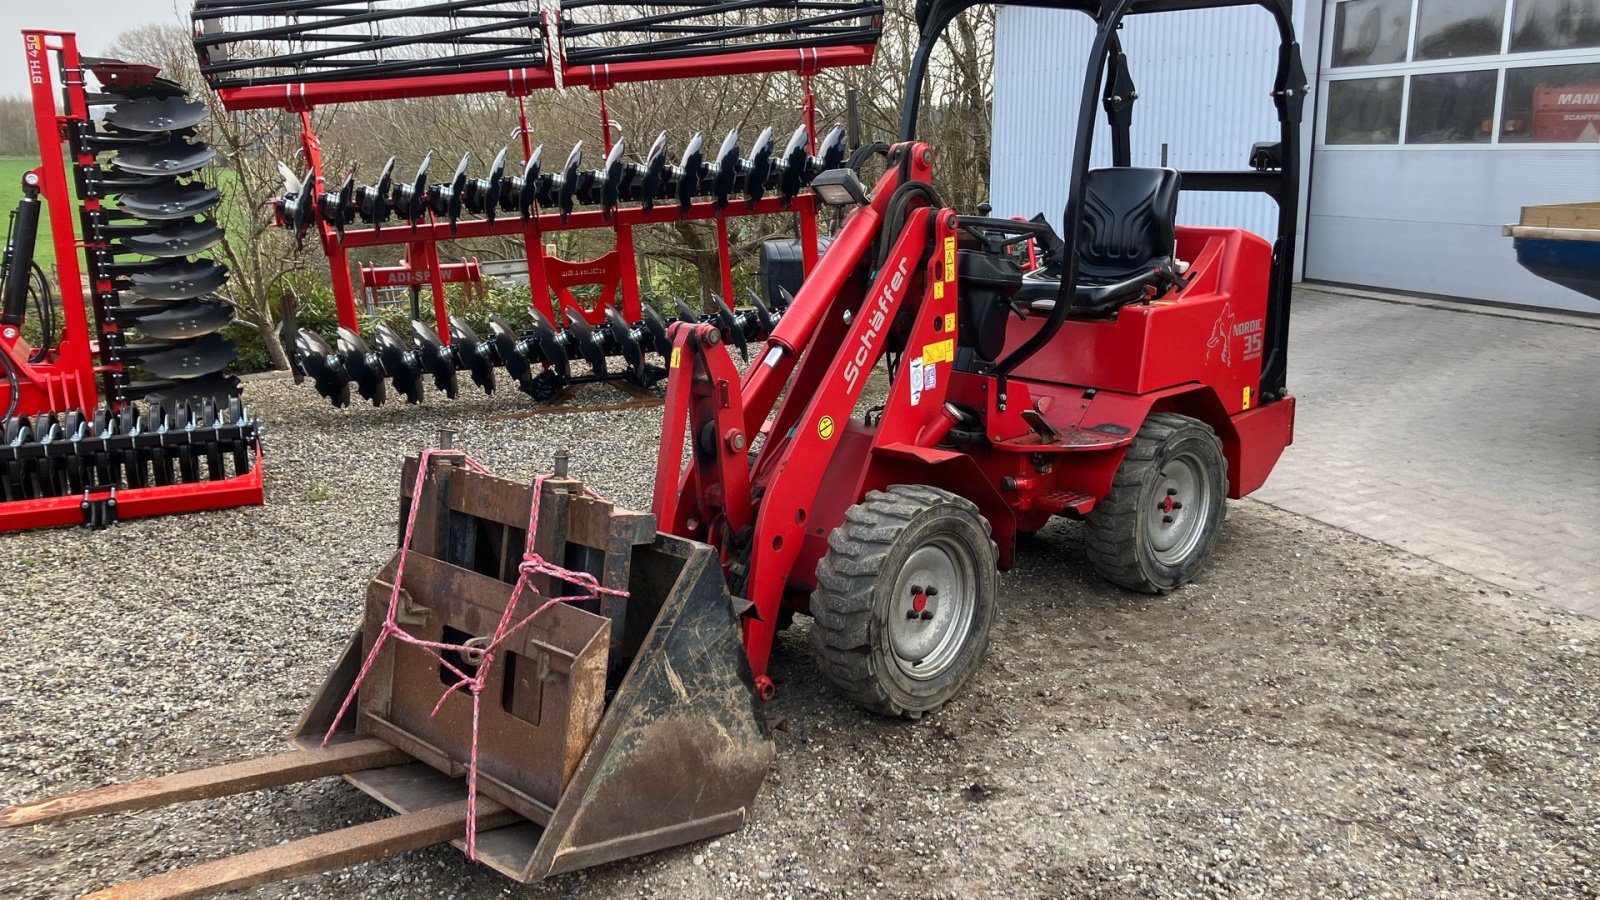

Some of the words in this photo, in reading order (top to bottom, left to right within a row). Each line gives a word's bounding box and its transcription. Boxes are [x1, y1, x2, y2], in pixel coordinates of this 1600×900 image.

[26, 34, 38, 57] 450
[30, 60, 42, 83] BTH
[388, 269, 452, 283] ADI-SPW
[844, 257, 907, 395] Schäffer
[1233, 319, 1262, 336] NORDIC
[1243, 333, 1261, 354] 35
